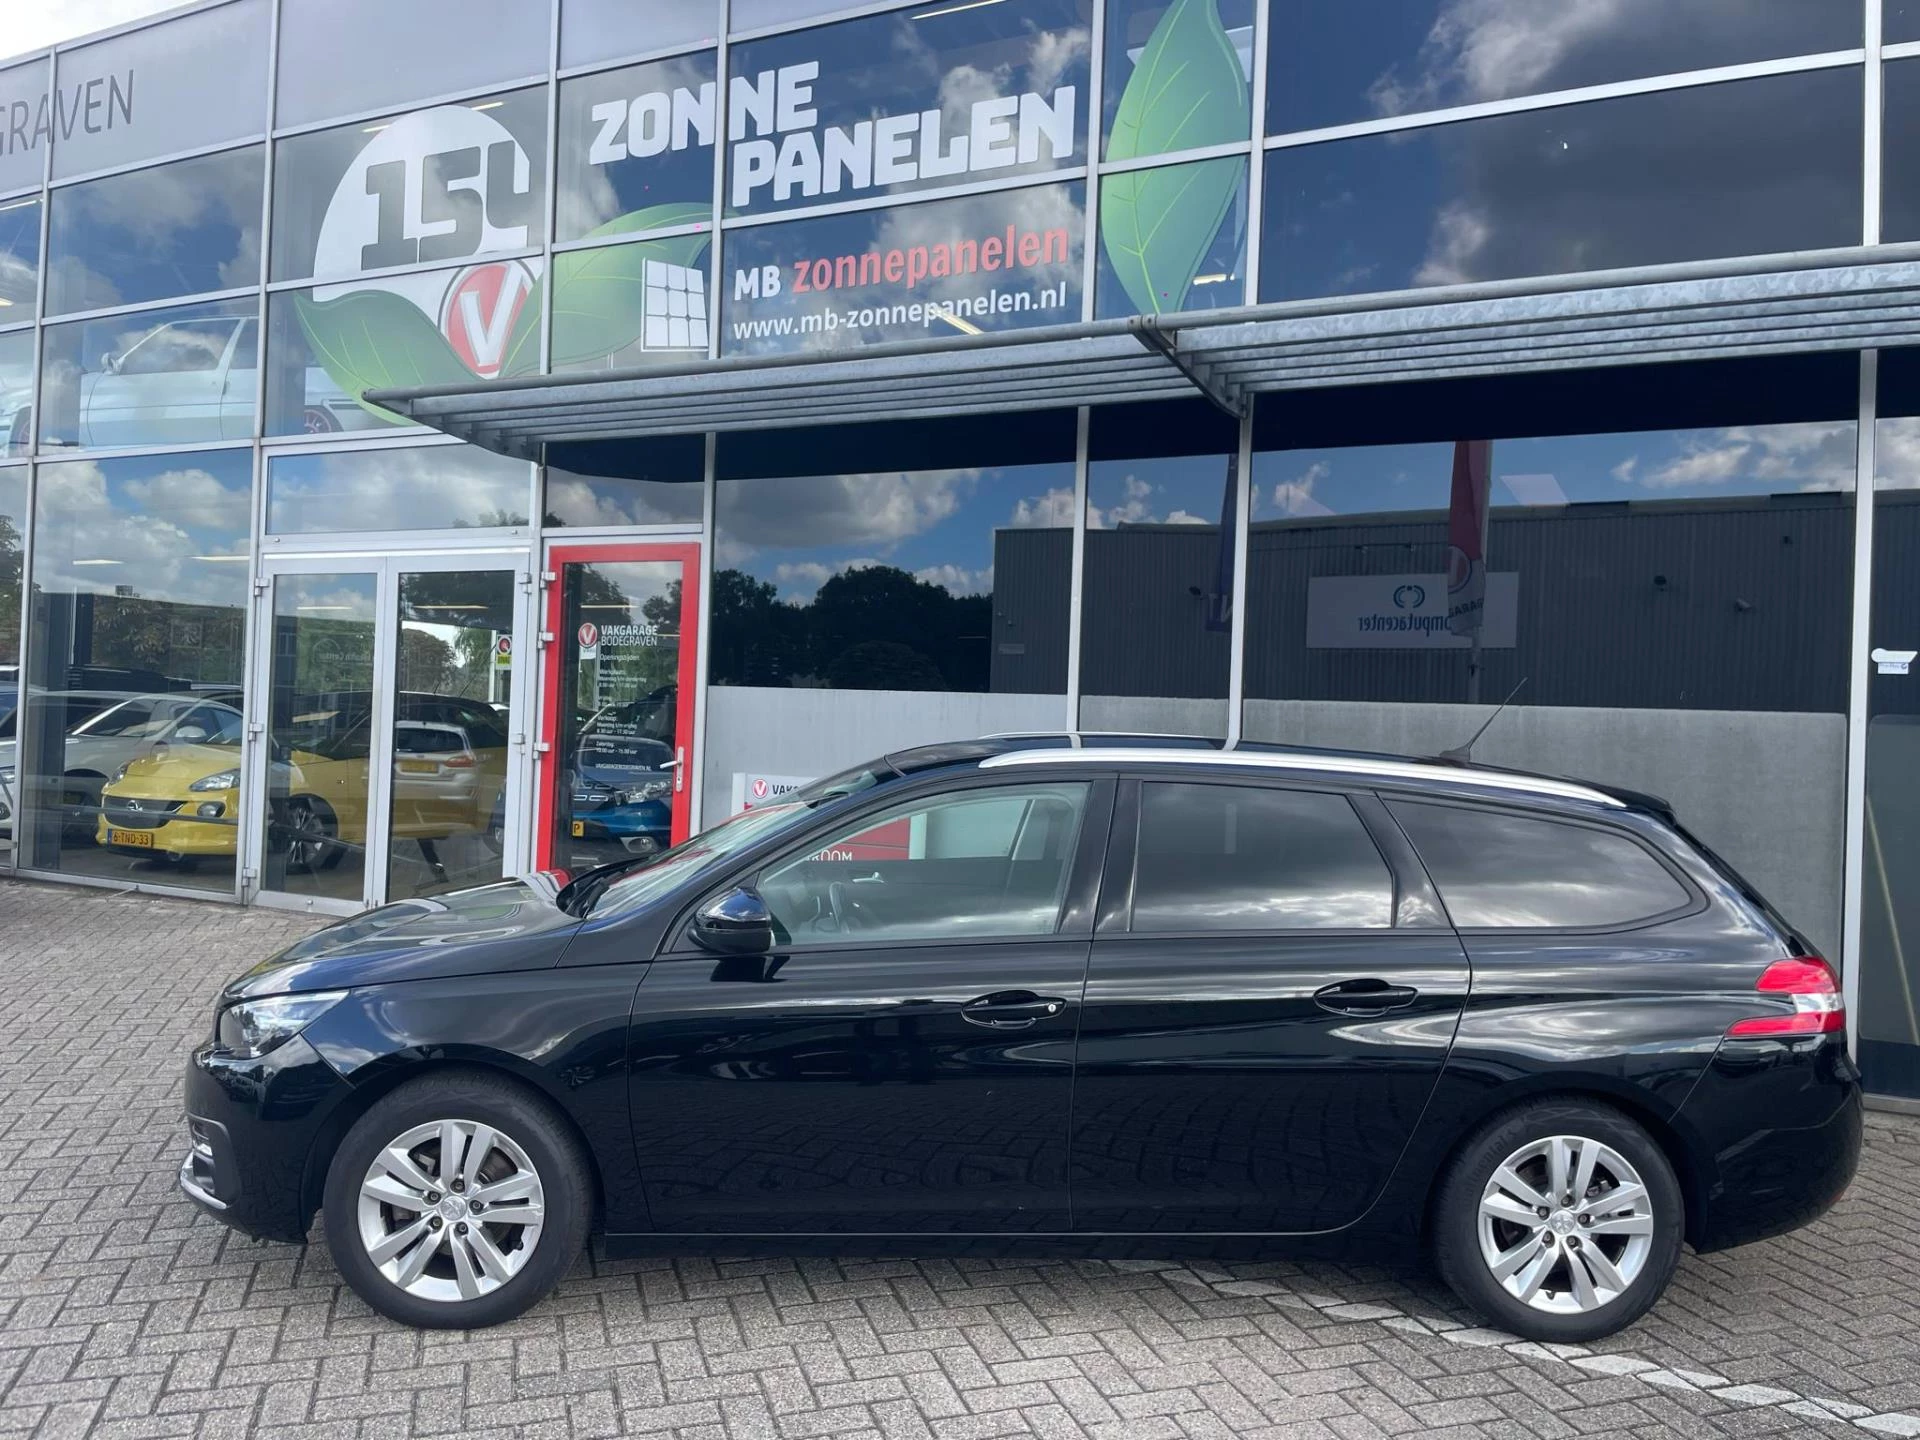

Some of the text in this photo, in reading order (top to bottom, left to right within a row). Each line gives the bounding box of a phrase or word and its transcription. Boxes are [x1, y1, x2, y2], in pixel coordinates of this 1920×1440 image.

[589, 60, 819, 166] ZONNE
[732, 85, 1076, 207] PANELEN
[733, 223, 1069, 302] MB zonnepanelen
[733, 281, 1067, 340] www.mb-zonnepanelen.nl
[601, 625, 658, 636] VAKGARAGE
[601, 635, 657, 646] BODEGRAVEN
[772, 784, 798, 795] VAK
